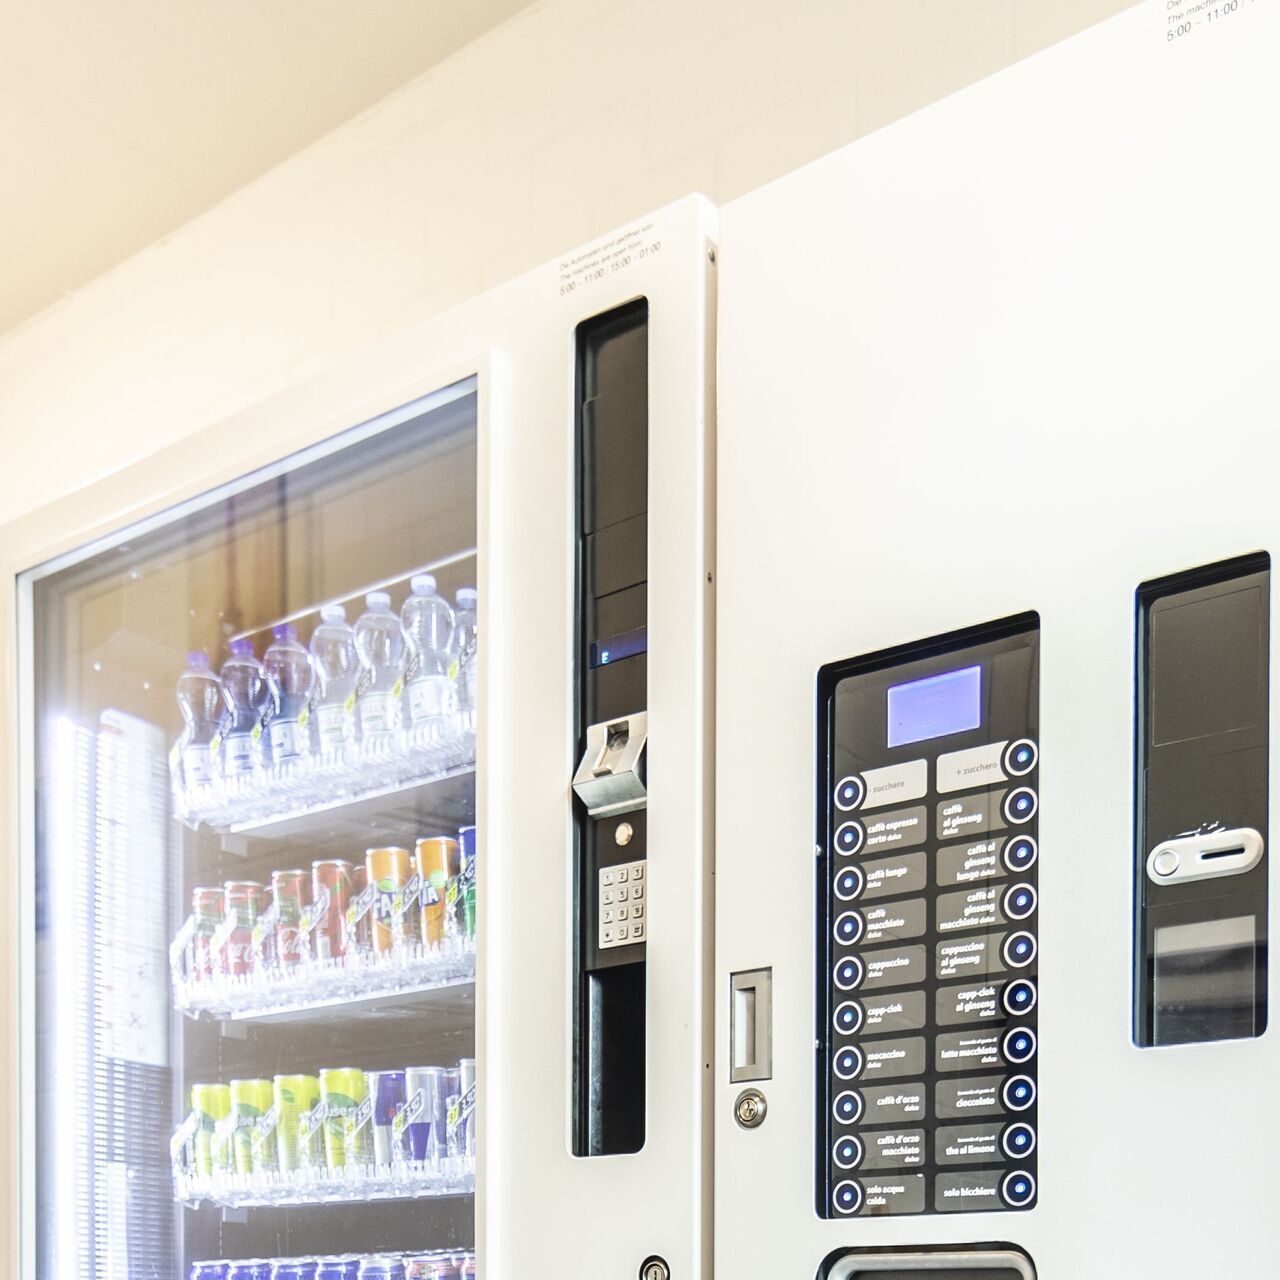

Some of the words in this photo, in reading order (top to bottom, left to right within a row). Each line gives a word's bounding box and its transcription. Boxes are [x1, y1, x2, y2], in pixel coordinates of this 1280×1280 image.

[1167, 13, 1183, 24] The
[1167, 21, 1192, 42] 5:00
[1207, 0, 1238, 22] 11:00
[963, 761, 998, 775] zucchero
[873, 780, 905, 793] zucchero
[943, 804, 962, 816] caffè
[868, 822, 885, 834] caffè
[886, 818, 918, 831] espresso
[943, 818, 950, 827] al
[952, 813, 982, 827] ginseng
[868, 834, 886, 845] corto
[967, 844, 986, 855] caffè
[987, 842, 996, 852] al
[964, 855, 996, 870] ginseng
[867, 869, 885, 880] caffè
[886, 867, 907, 877] lungo
[957, 870, 979, 881] lungo
[967, 891, 986, 902] caffè
[987, 890, 995, 899] al
[868, 908, 886, 920] caffè
[964, 903, 995, 916] ginseng
[868, 918, 905, 930] macchiato
[940, 918, 979, 930] macchiato
[941, 942, 984, 956] cappuccino
[868, 958, 909, 970] cappuccino
[941, 957, 948, 967] al
[949, 954, 980, 968] ginseng
[957, 987, 996, 1000] capp-ciok
[868, 1003, 903, 1016] capp-ciok
[956, 1002, 963, 1012] al
[964, 1000, 995, 1013] ginseng
[867, 1050, 906, 1061] mocaccino
[941, 1050, 958, 1058] latte
[959, 1046, 997, 1057] macchiato
[877, 1096, 895, 1105] caffè
[956, 1096, 995, 1108] cioccolato
[877, 1136, 895, 1145] caffè
[882, 1147, 920, 1156] macchiato
[946, 1147, 959, 1156] the
[960, 1146, 967, 1154] al
[968, 1145, 995, 1154] limone
[867, 1185, 882, 1194] solo
[883, 1186, 905, 1195] acqua
[944, 1188, 960, 1197] solo
[961, 1187, 996, 1196] bicchiere
[867, 1196, 886, 1205] calda
